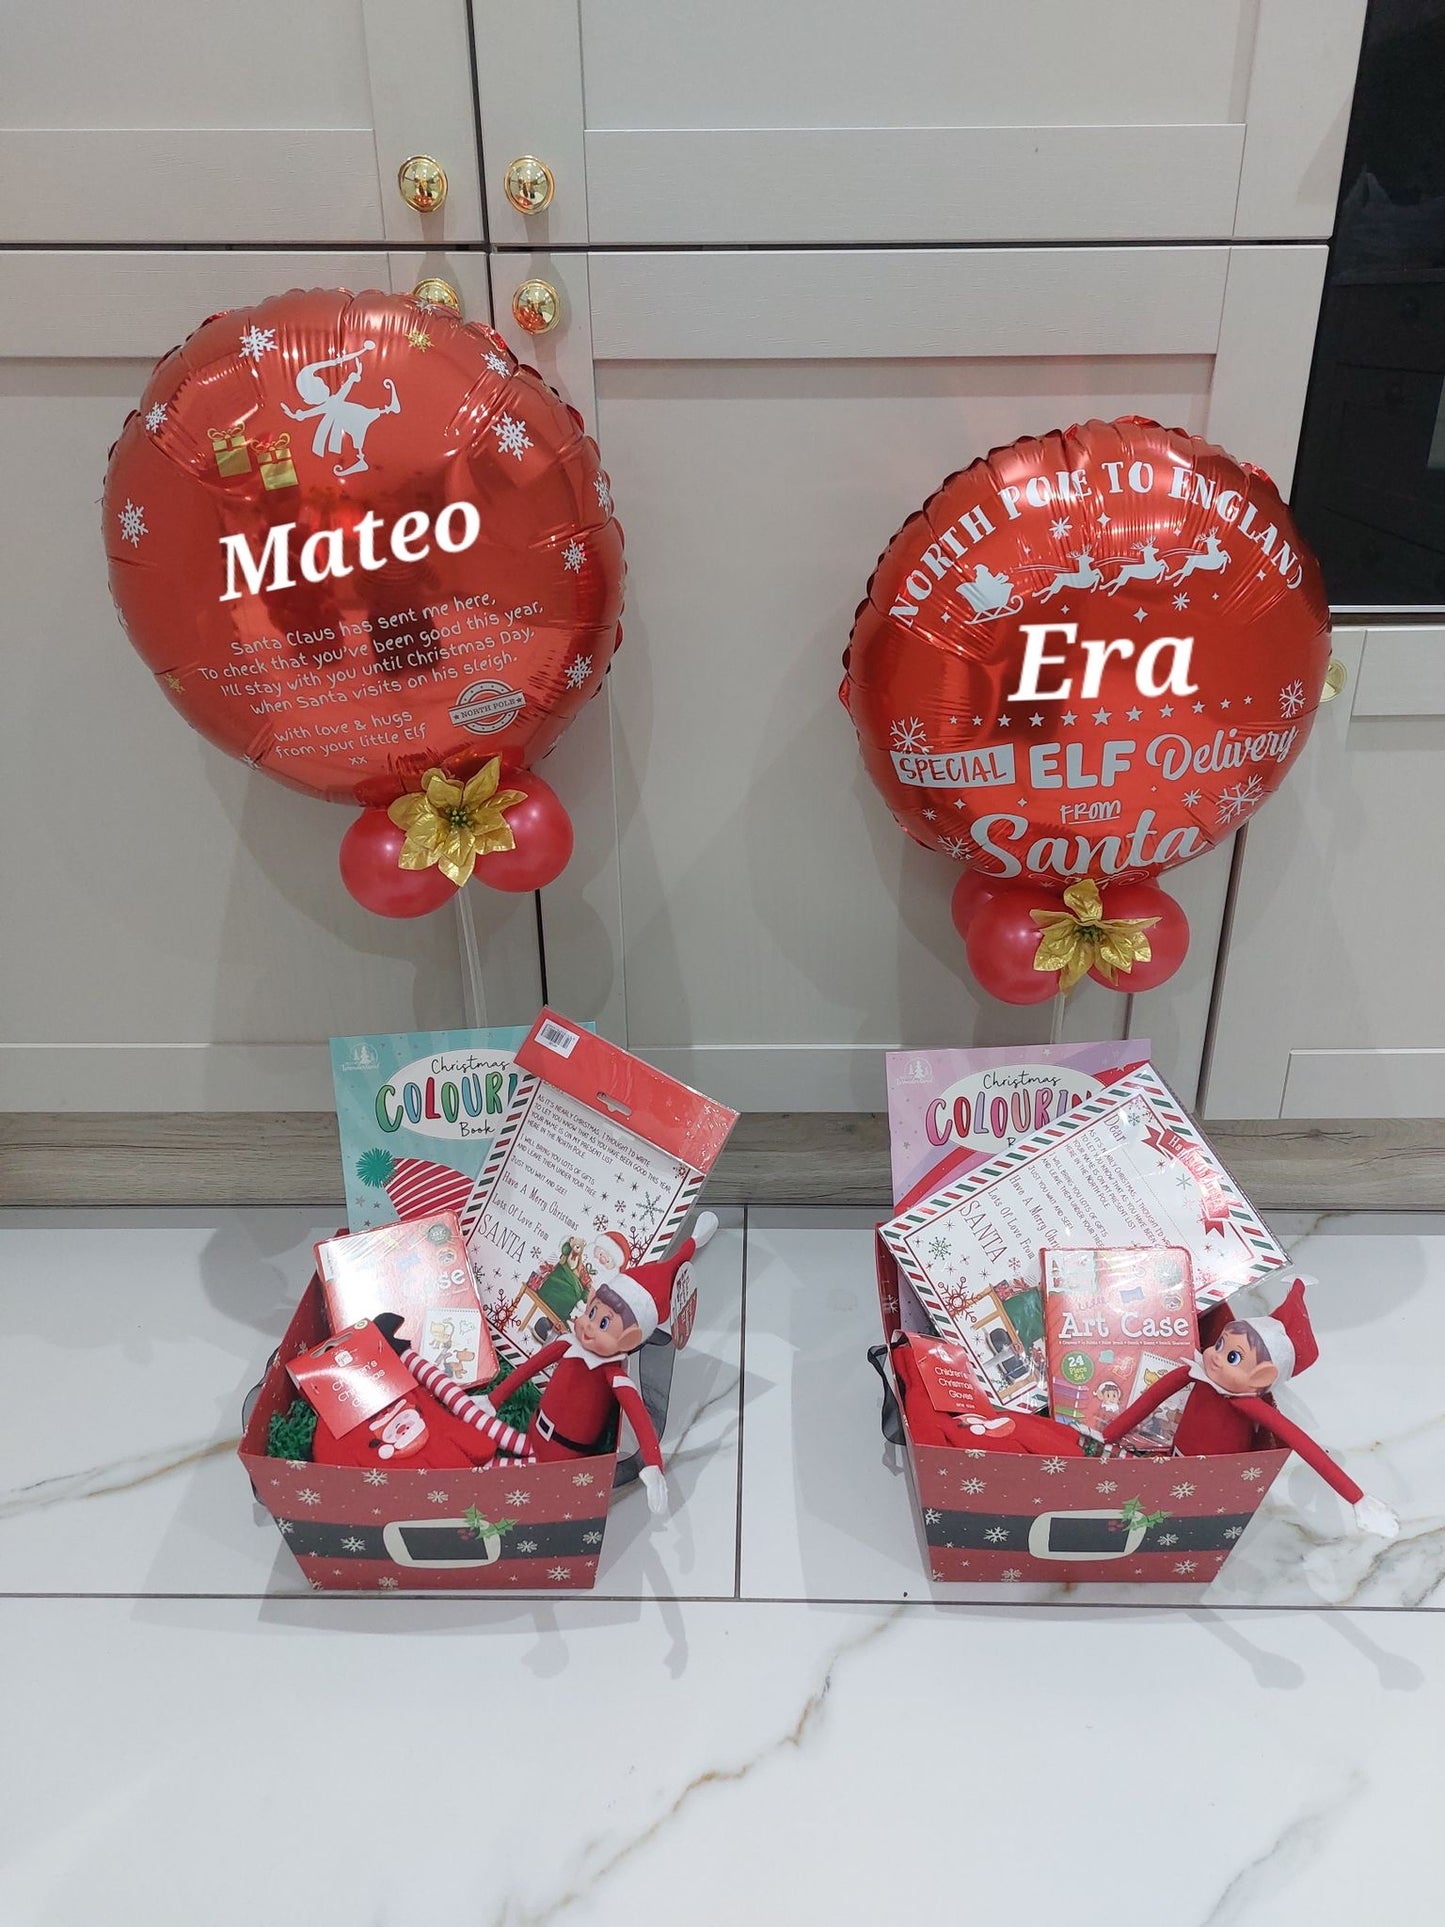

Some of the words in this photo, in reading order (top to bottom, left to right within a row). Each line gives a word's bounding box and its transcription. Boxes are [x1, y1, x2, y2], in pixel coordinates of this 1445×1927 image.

[889, 504, 997, 628] NORTH
[998, 468, 1092, 520] POLE
[1101, 461, 1154, 494] TO
[1168, 466, 1303, 590] ENGLAND
[199, 668, 218, 680] To
[224, 658, 268, 678] check
[270, 652, 308, 670] that
[312, 644, 368, 670] you've
[372, 634, 414, 654] been
[420, 620, 462, 648] good
[466, 612, 500, 630] this
[504, 600, 544, 627] year,
[230, 632, 282, 656] Santa
[286, 628, 336, 646] Claus
[338, 618, 372, 636] has
[378, 608, 418, 630] sent
[422, 604, 448, 620] me
[454, 594, 496, 612] here,
[220, 684, 242, 696] I'll
[244, 680, 282, 704] stay
[286, 668, 322, 690] with
[326, 668, 356, 690] you
[362, 656, 402, 676] until
[406, 636, 496, 666] Christmas
[250, 694, 292, 714] When
[296, 688, 348, 708] Santa
[352, 680, 402, 700] visits
[408, 676, 428, 688] on
[432, 666, 458, 682] his
[464, 650, 518, 674] sleigh.
[314, 722, 348, 736] love
[354, 720, 366, 730] &
[370, 712, 412, 728] hugs
[460, 705, 492, 719] NORTH
[493, 698, 516, 710] POLE
[276, 746, 316, 758] from
[320, 740, 354, 758] your
[360, 732, 398, 748] little
[404, 722, 426, 740] Elf
[899, 752, 1007, 784] SPECIAL
[1029, 740, 1137, 789] ELF
[1146, 725, 1299, 781] Delivery
[1060, 799, 1121, 824] FROM
[970, 809, 1213, 879] Santa
[431, 1055, 510, 1075] Christmas
[983, 1070, 1061, 1090] Christmas
[459, 1119, 496, 1137] Book
[525, 1118, 540, 1131] HERE
[544, 1129, 556, 1140] THE
[554, 1135, 574, 1151] NORTH
[529, 1110, 544, 1123] YOUR
[542, 1118, 559, 1131] NAME
[571, 1135, 581, 1145] MY
[578, 1140, 602, 1158] PRESENT
[533, 1102, 542, 1110] TO
[540, 1106, 551, 1116] LET
[550, 1112, 563, 1123] YOU
[561, 1118, 577, 1132] KNOW
[575, 1127, 589, 1139] THAT
[588, 1135, 597, 1144] AS
[595, 1140, 607, 1150] YOU
[605, 1146, 620, 1158] HAVE
[618, 1154, 634, 1167] BEEN
[631, 1162, 648, 1176] GOOD
[645, 1172, 660, 1184] THIS
[553, 1104, 574, 1119] NEARLY
[603, 1134, 629, 1153] THOUGHT
[634, 1153, 651, 1167] WRITE
[1104, 1114, 1126, 1142] Dear
[515, 1142, 527, 1152] AND
[526, 1148, 542, 1161] LEAVE
[540, 1157, 557, 1170] THEM
[554, 1165, 572, 1180] UNDER
[570, 1176, 585, 1189] YOUR
[523, 1135, 537, 1147] WILL
[535, 1142, 552, 1156] BRING
[549, 1151, 562, 1163] YOU
[559, 1158, 575, 1171] LOTS
[1063, 1142, 1077, 1158] HERE
[1072, 1156, 1082, 1165] IN
[1077, 1163, 1089, 1175] THE
[1084, 1173, 1102, 1194] NORTH
[523, 1163, 536, 1174] YOU
[533, 1170, 547, 1181] WAIT
[544, 1177, 556, 1188] AND
[1026, 1164, 1041, 1182] JUST
[1037, 1179, 1049, 1194] YOU
[1044, 1191, 1057, 1205] WAIT
[1053, 1203, 1065, 1217] AND
[1040, 1156, 1052, 1169] AND
[1048, 1168, 1063, 1186] LEAVE
[1059, 1184, 1073, 1201] THEM
[1069, 1199, 1085, 1219] UNDER
[1081, 1218, 1095, 1235] YOUR
[1071, 1138, 1085, 1154] YOUR
[1081, 1152, 1096, 1170] NAME
[1095, 1174, 1106, 1185] ON
[1101, 1183, 1112, 1194] MY
[1107, 1191, 1128, 1218] PRESENT
[1084, 1141, 1096, 1153] LET
[1099, 1163, 1115, 1181] KNOW
[1111, 1180, 1124, 1195] THAT
[1119, 1192, 1129, 1203] AS
[1125, 1201, 1137, 1214] YOU
[1133, 1212, 1146, 1228] HAVE
[1143, 1226, 1157, 1243] BEEN
[492, 1192, 508, 1210] Lots
[508, 1204, 519, 1216] Of
[516, 1210, 532, 1228] Love
[534, 1222, 550, 1241] From
[502, 1170, 518, 1188] Have
[520, 1184, 528, 1194] A
[528, 1186, 548, 1212] Merry
[548, 1200, 580, 1231] Christmas
[988, 1188, 1002, 1206] Lots
[1000, 1206, 1014, 1218] Of
[1010, 1174, 1024, 1196] Have
[1022, 1196, 1034, 1206] A
[1028, 1204, 1048, 1232] Merry
[1051, 1155, 1064, 1171] WILL
[1059, 1168, 1075, 1187] BRING
[1070, 1185, 1083, 1199] YOU
[1078, 1196, 1092, 1213] LOTS
[1088, 1210, 1098, 1221] OF
[1093, 1219, 1109, 1238] GIFTS
[1137, 1201, 1159, 1229] THOUGHT
[478, 1214, 526, 1263] SANTA
[958, 1200, 1008, 1264] SANTA
[1006, 1218, 1022, 1238] Love
[1020, 1238, 1039, 1260] From
[1058, 1312, 1109, 1339] Art
[1120, 1311, 1189, 1338] Case
[1067, 1355, 1085, 1368] 24
[1069, 1366, 1088, 1375] Piece
[1073, 1372, 1086, 1381] Set
[938, 1377, 974, 1390] Christmas
[948, 1389, 974, 1400] Gloves
